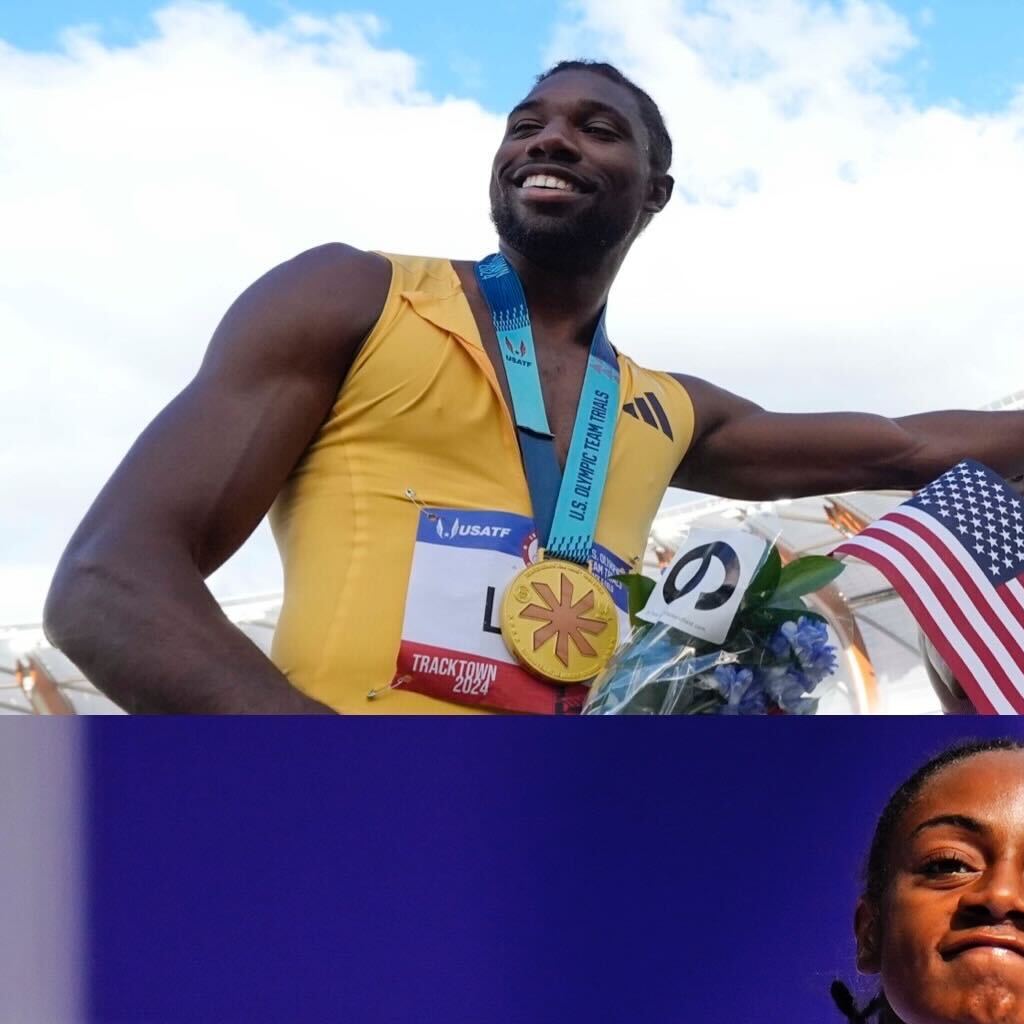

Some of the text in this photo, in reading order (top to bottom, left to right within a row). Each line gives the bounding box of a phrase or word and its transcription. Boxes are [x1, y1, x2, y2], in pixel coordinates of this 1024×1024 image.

[505, 355, 532, 368] USATF
[569, 390, 610, 522] U.S. OLYMPIC TEAM TRIALS
[458, 524, 512, 538] USATF
[412, 654, 498, 682] TRACKTOWN
[452, 676, 491, 696] 2024
